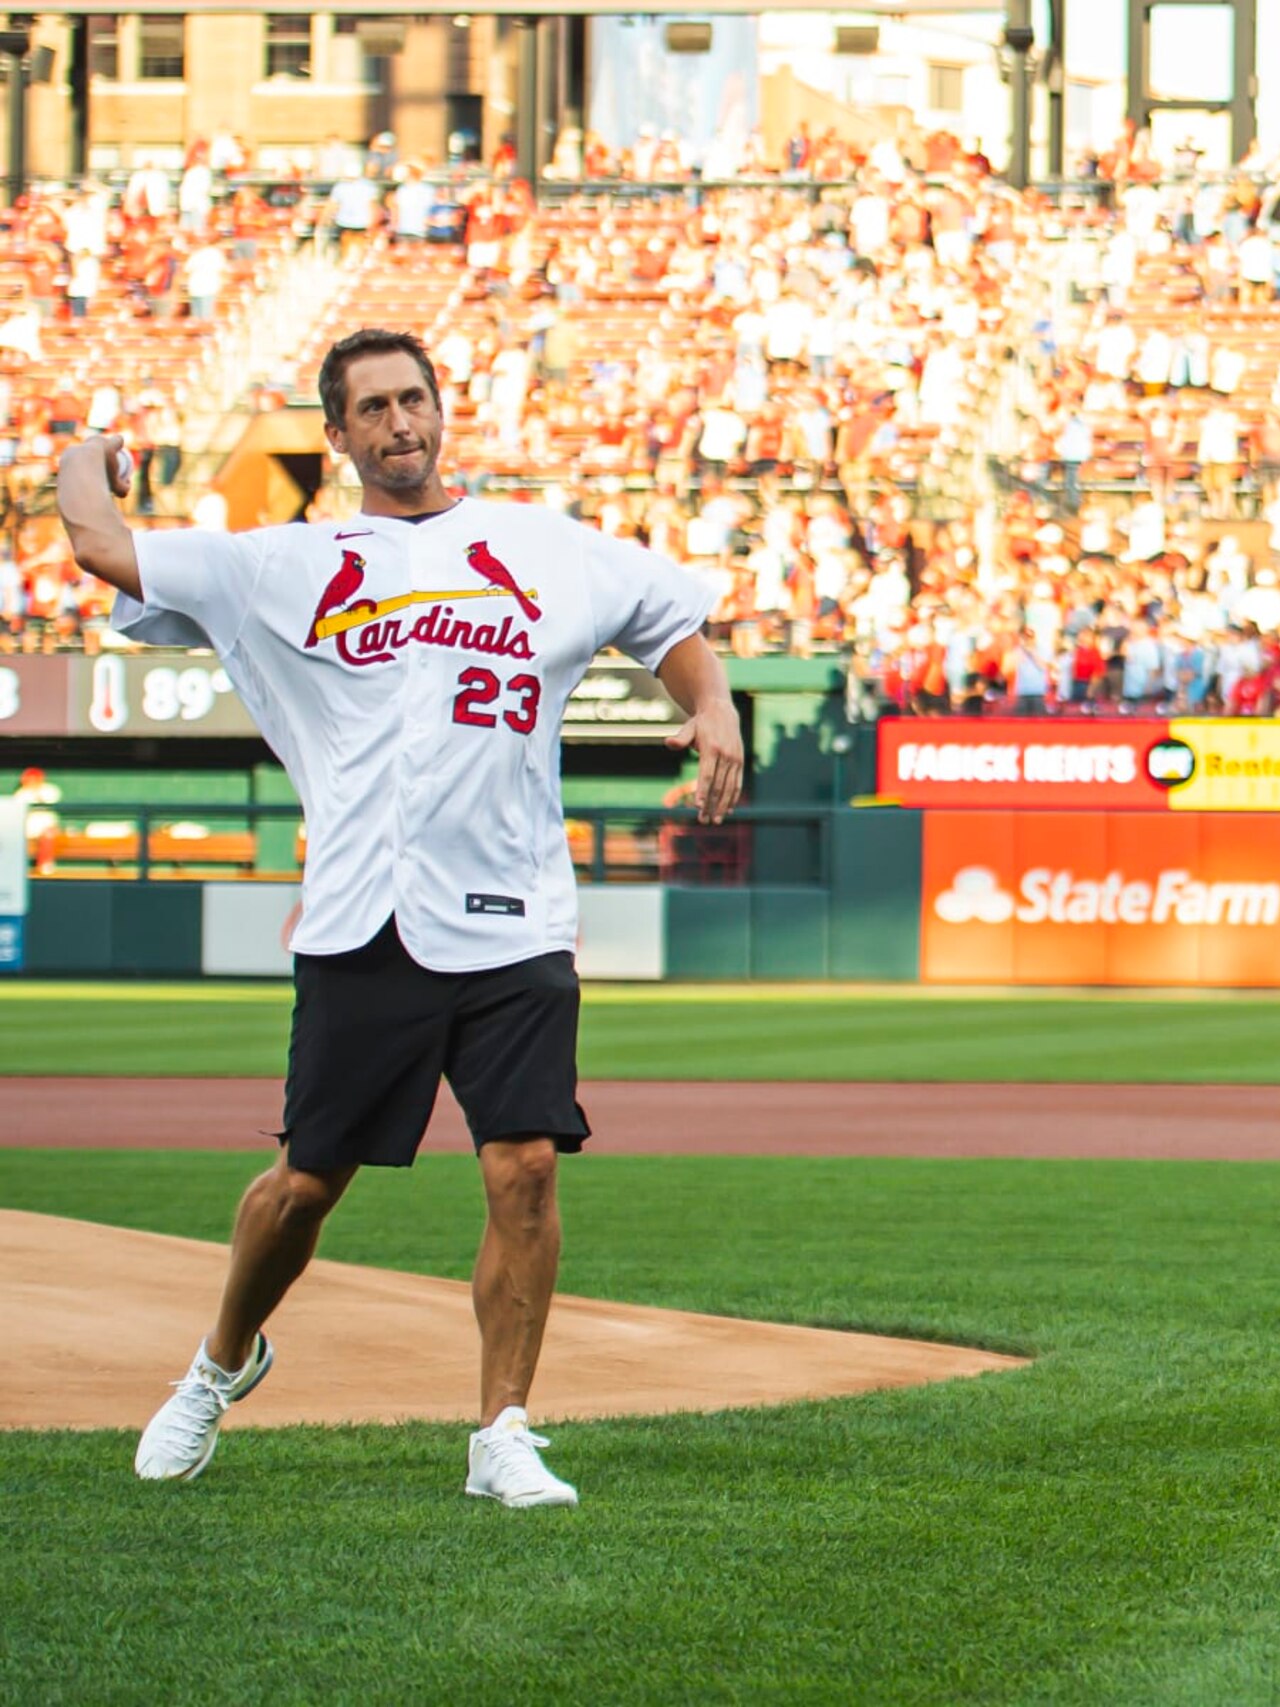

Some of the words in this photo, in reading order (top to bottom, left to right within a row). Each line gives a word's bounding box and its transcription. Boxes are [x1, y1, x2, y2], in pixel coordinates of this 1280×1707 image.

[335, 598, 536, 667] Cardinals
[452, 665, 542, 736] 23
[898, 744, 1020, 782] FABICK
[1024, 745, 1136, 783] RENTS
